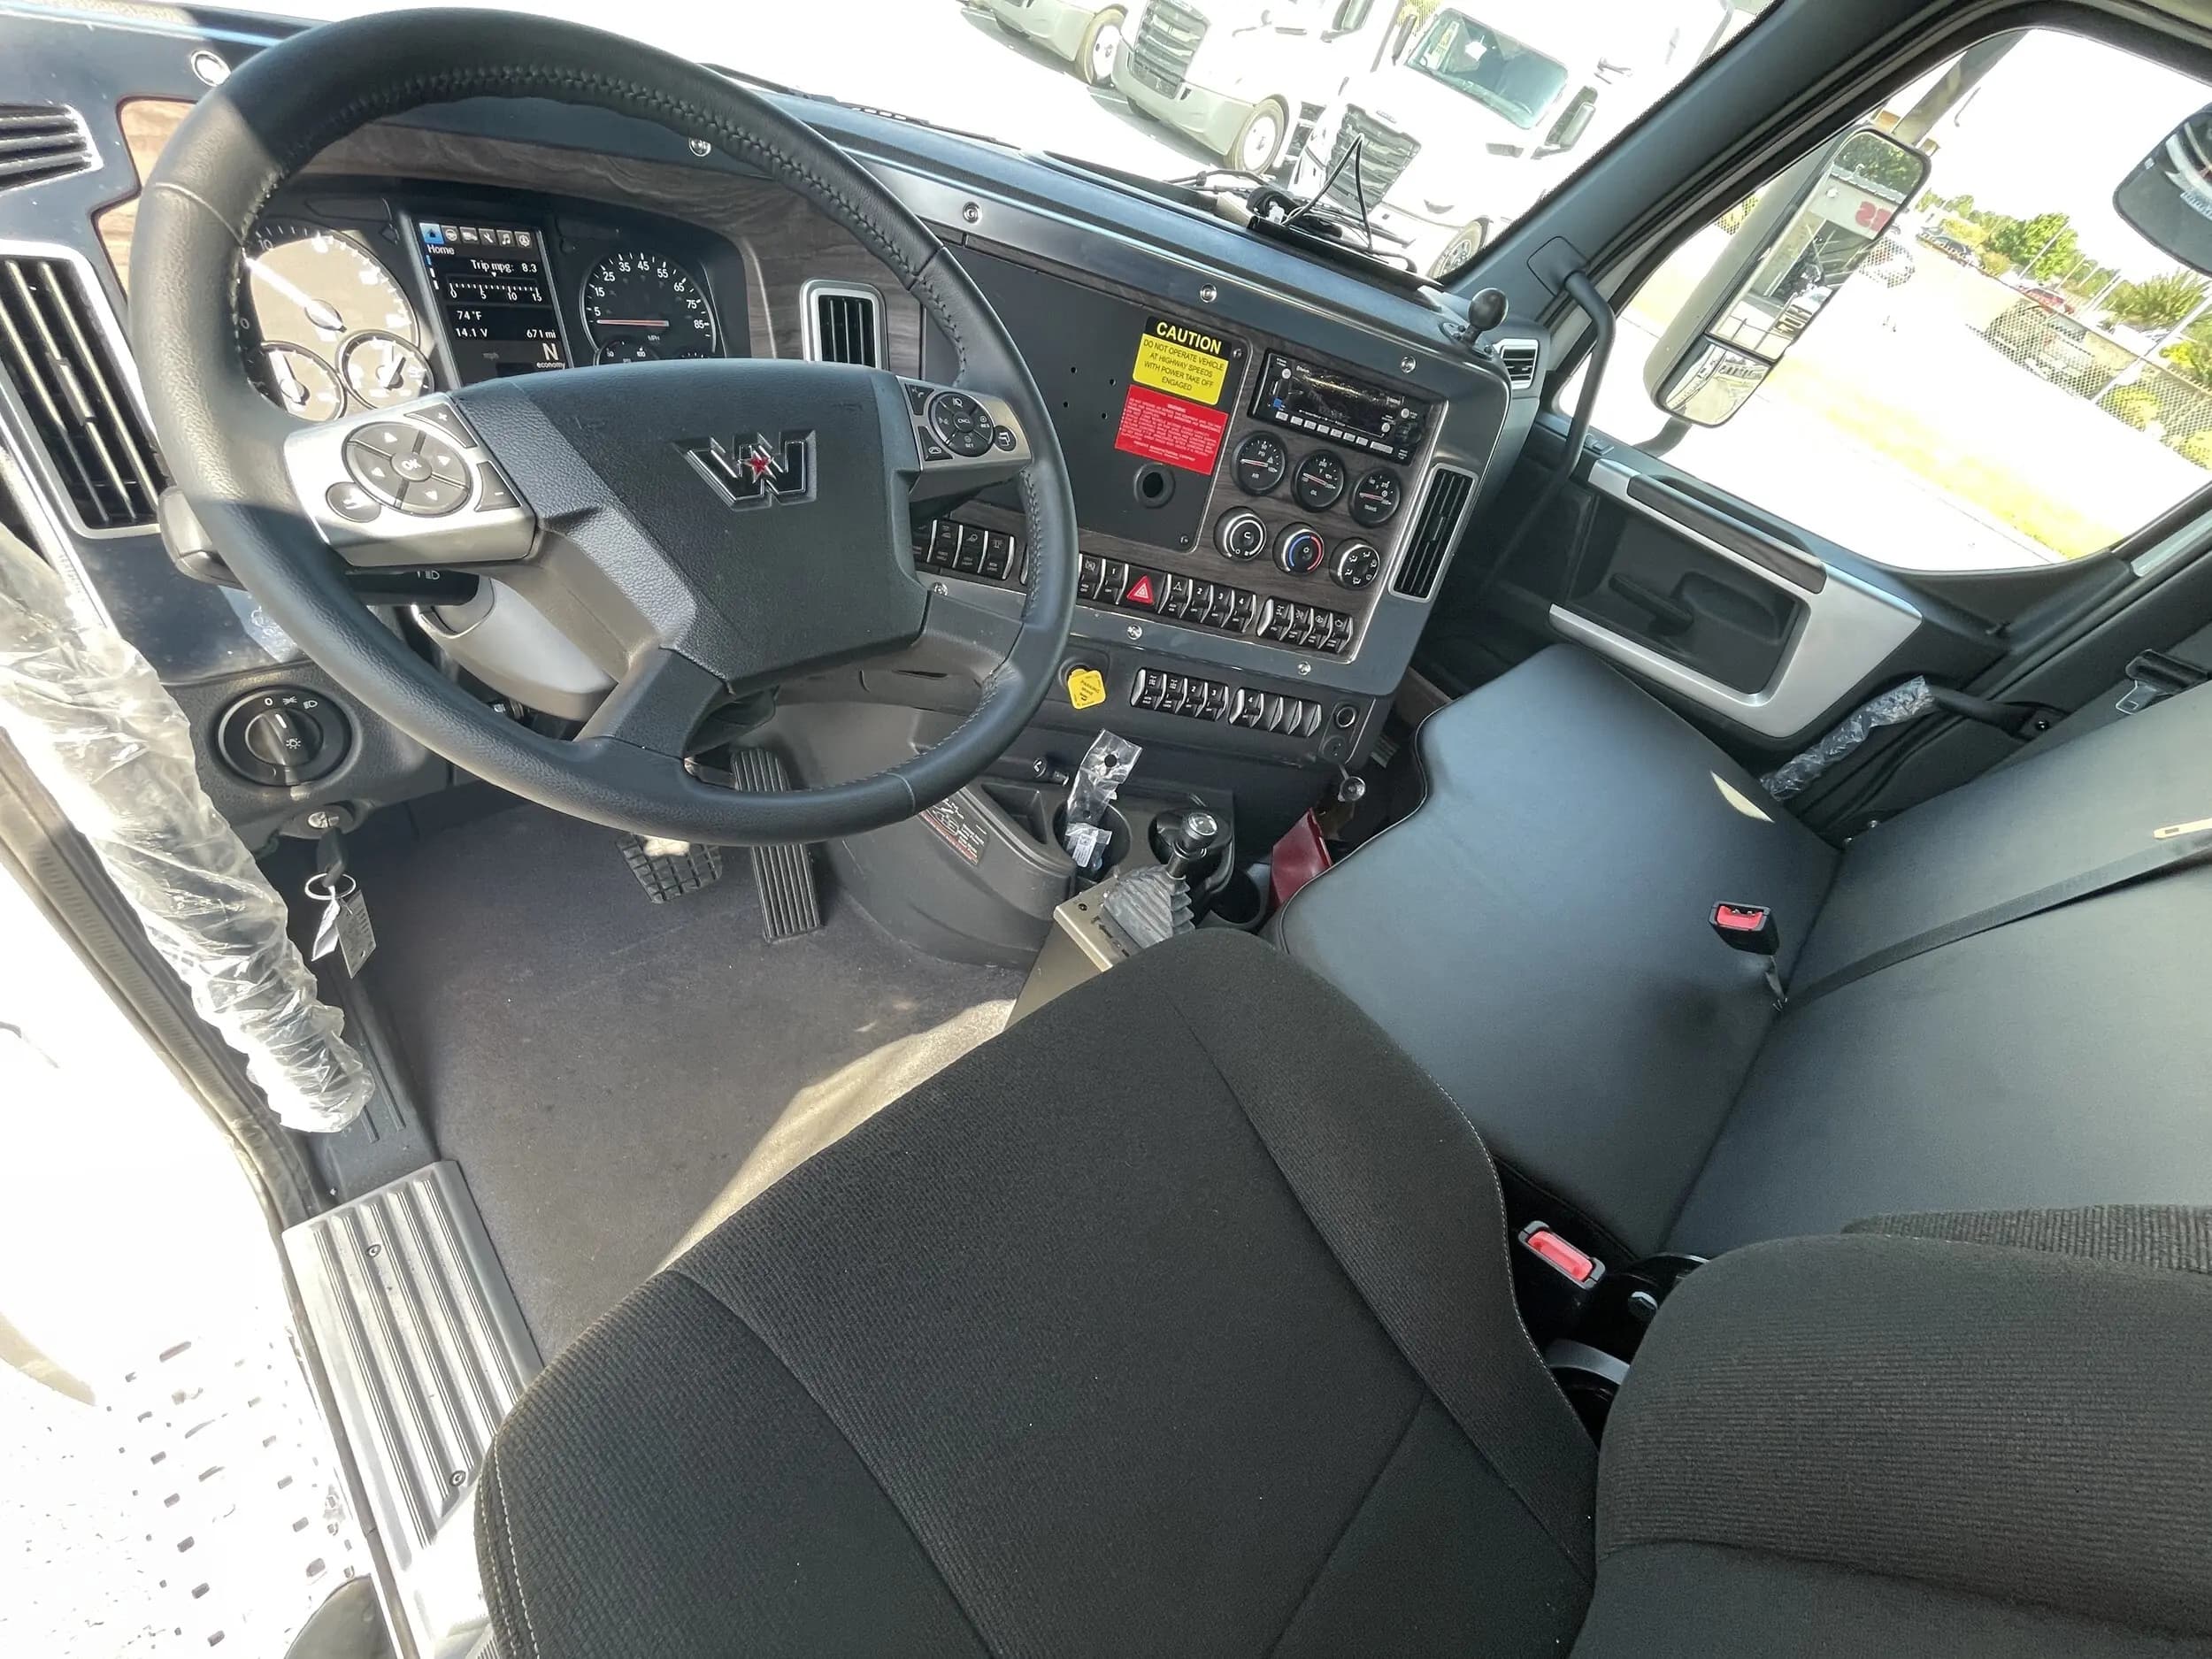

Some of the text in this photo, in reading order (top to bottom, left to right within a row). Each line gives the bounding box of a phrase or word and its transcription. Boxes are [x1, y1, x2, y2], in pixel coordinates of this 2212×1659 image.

[427, 244, 455, 255] Home
[471, 259, 537, 273] Trip mpg: 8.3
[618, 262, 631, 273] 35
[637, 260, 650, 271] 45
[603, 271, 616, 282] 25
[657, 268, 669, 279] 55
[595, 287, 605, 297] 15
[673, 282, 685, 292] 65
[449, 290, 542, 302] 0 5 10 15
[686, 299, 697, 310] 75
[594, 307, 602, 317] 5
[693, 319, 705, 329] 85
[456, 328, 488, 338] 14.1 V
[526, 329, 557, 339] 671 mi
[1156, 321, 1222, 355] CAUTION
[542, 342, 559, 361] N
[1143, 339, 1225, 372] DO NOT OPERATE VEHICLE
[1149, 352, 1213, 378] AT HIGHWAY SPEEDS
[1144, 361, 1215, 388] WITH POWER TAKE OFF
[1161, 376, 1193, 391] ENGAGED
[402, 458, 422, 471] OK
